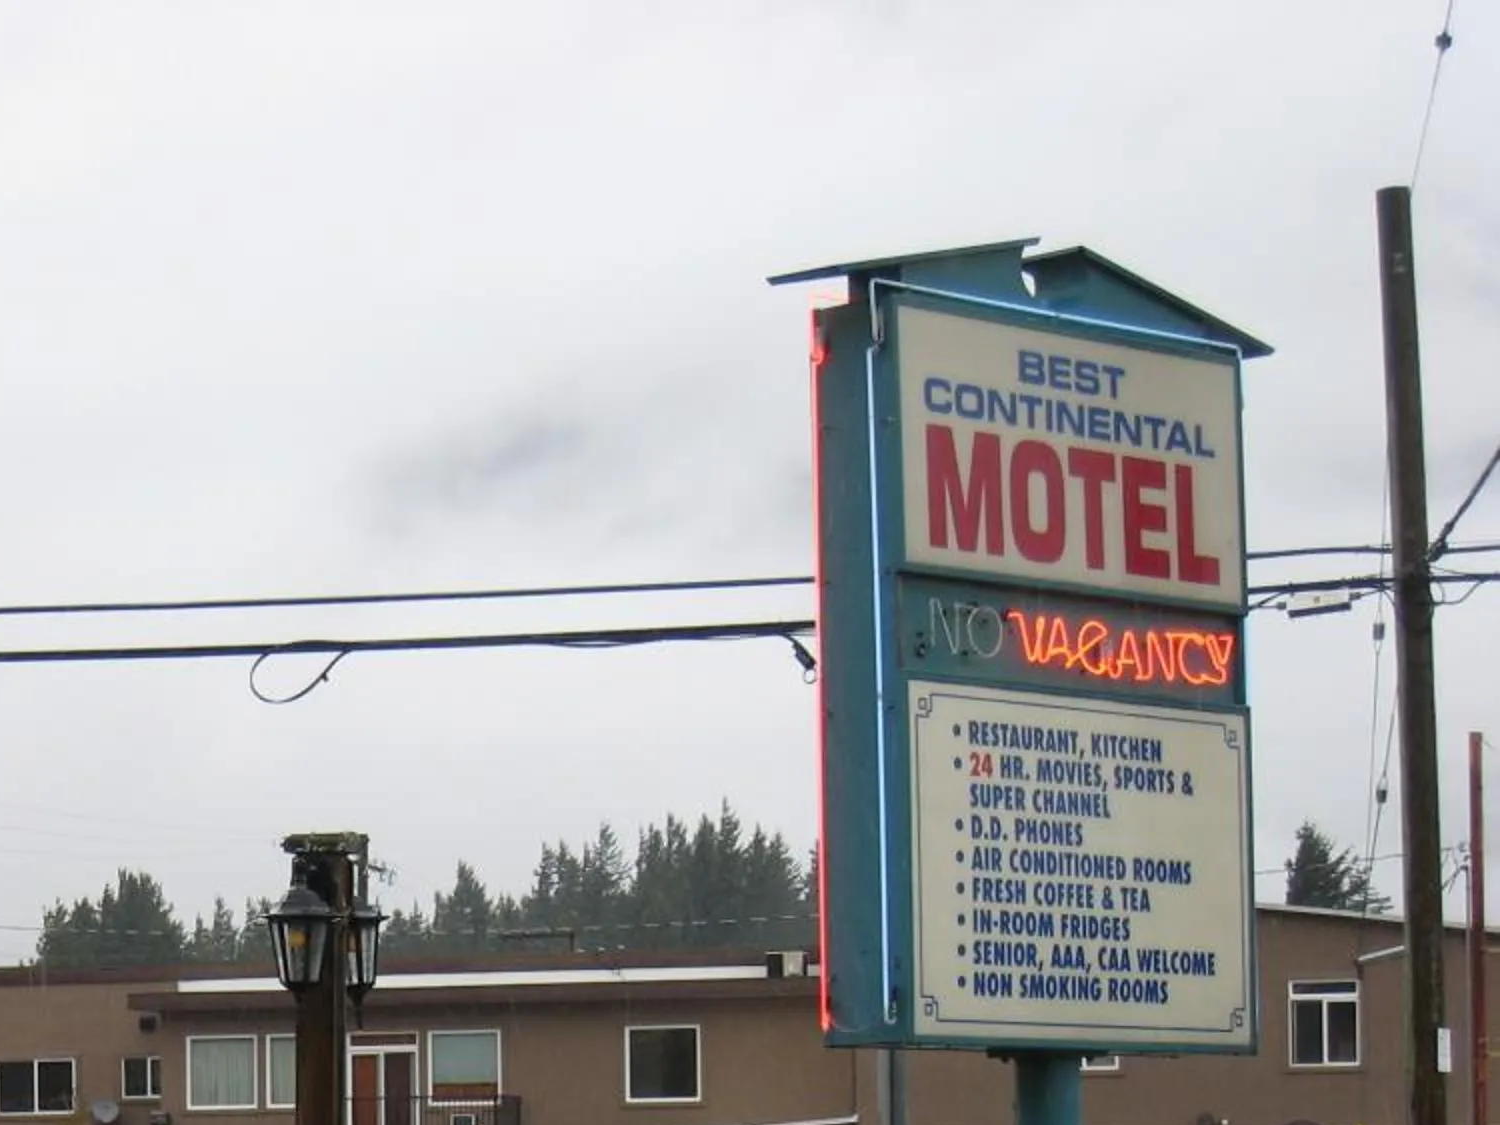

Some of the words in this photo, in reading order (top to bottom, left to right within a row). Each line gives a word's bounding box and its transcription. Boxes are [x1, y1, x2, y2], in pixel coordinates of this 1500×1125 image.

[1017, 350, 1125, 398] BEST
[924, 377, 1215, 458] CONTINENTAL
[925, 424, 1220, 585] MOTEL
[929, 597, 1003, 657] NO
[1007, 608, 1234, 685] VACANCY
[968, 721, 1085, 760] RESTAURANT,
[1091, 733, 1162, 763] KITCHEN
[969, 752, 993, 777] 24
[1000, 754, 1030, 780] HR.
[1036, 758, 1108, 792] MOVIES,
[1114, 766, 1174, 794] SPORTS
[1181, 772, 1193, 796] &
[969, 784, 1026, 811] SUPER
[1032, 789, 1111, 819] CHANNEL
[970, 816, 1008, 842] D.D.
[1015, 819, 1083, 847] PHONES
[971, 848, 1002, 872] AIR
[1009, 850, 1126, 881] CONDITIONED
[1133, 859, 1192, 886] ROOMS
[972, 878, 1027, 905] FRESH
[1033, 881, 1095, 909] COFFEE
[1101, 886, 1114, 909] &
[1120, 887, 1151, 912] TEA
[972, 910, 1054, 938] IN-ROOM
[1061, 913, 1131, 942] FRIDGES
[972, 940, 1043, 971] SENIOR,
[1051, 943, 1092, 974] AAA,
[1098, 947, 1131, 972] CAA
[1136, 948, 1216, 976] WELCOME
[973, 971, 1013, 997] NON
[1019, 972, 1101, 1001] SMOKING
[1108, 978, 1169, 1005] ROOMS
